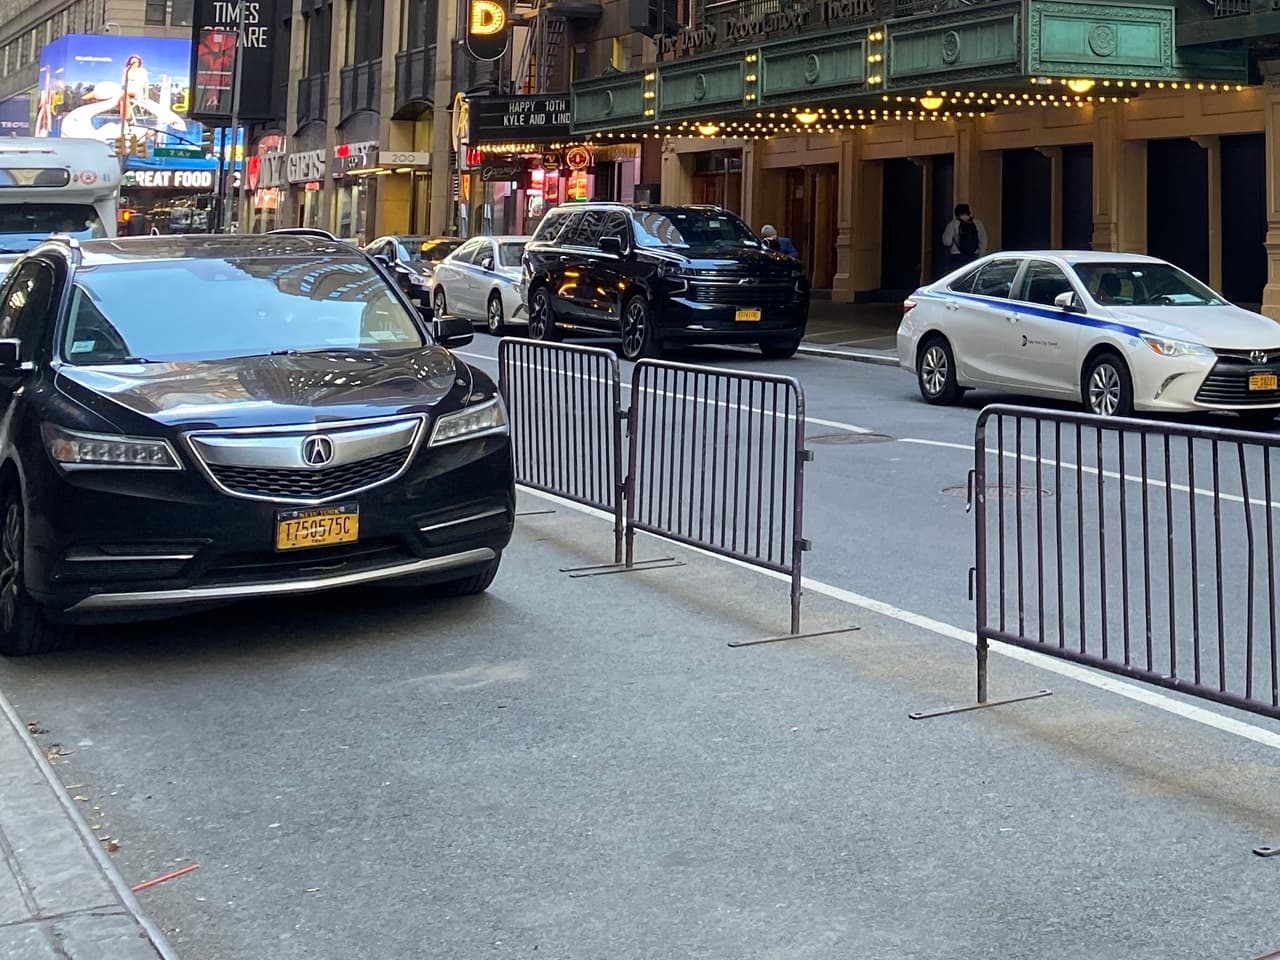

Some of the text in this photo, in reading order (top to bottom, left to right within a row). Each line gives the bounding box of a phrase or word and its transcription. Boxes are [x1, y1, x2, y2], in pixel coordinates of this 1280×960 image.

[213, 1, 260, 24] TIMES
[203, 26, 269, 48] ARE
[509, 100, 566, 113] HAPPY 10TH
[503, 114, 525, 127] KYLE
[529, 113, 546, 125] AND
[391, 153, 416, 164] 200
[173, 171, 212, 187] FOOD
[285, 515, 351, 542] T750575C
